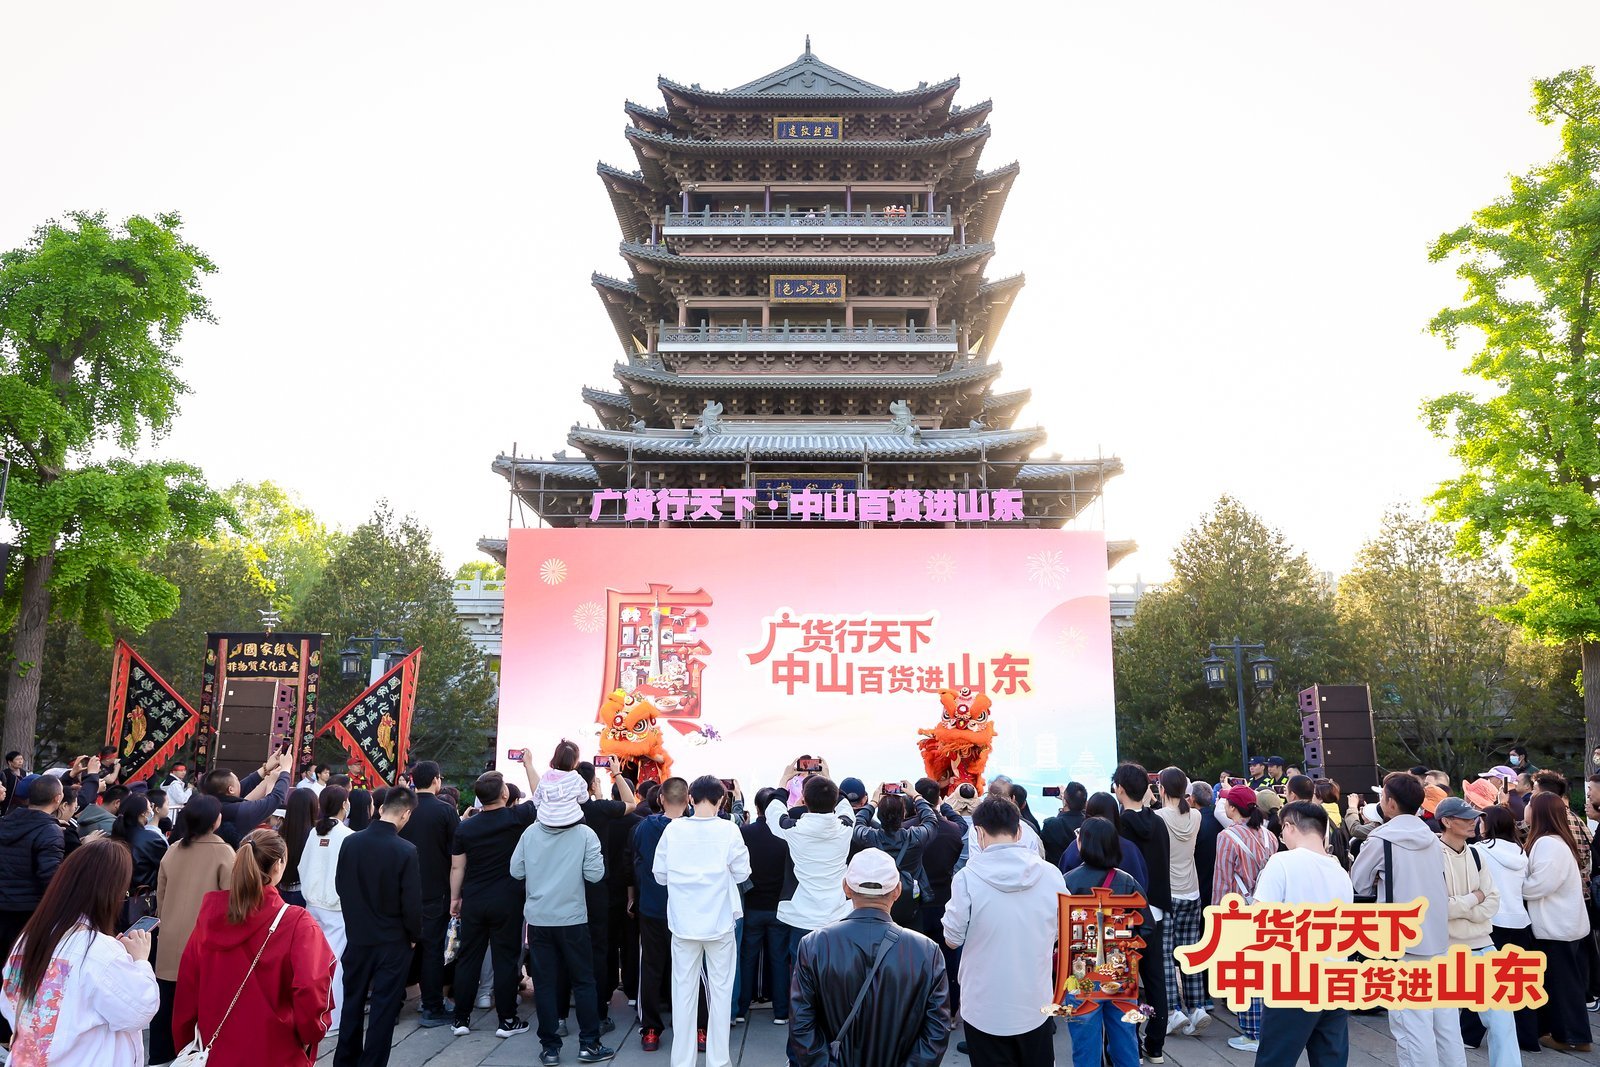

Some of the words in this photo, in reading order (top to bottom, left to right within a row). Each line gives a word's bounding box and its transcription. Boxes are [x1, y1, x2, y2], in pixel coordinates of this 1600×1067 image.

[746, 612, 934, 665] 广货行天下
[772, 653, 1031, 695] 中山百货进山东
